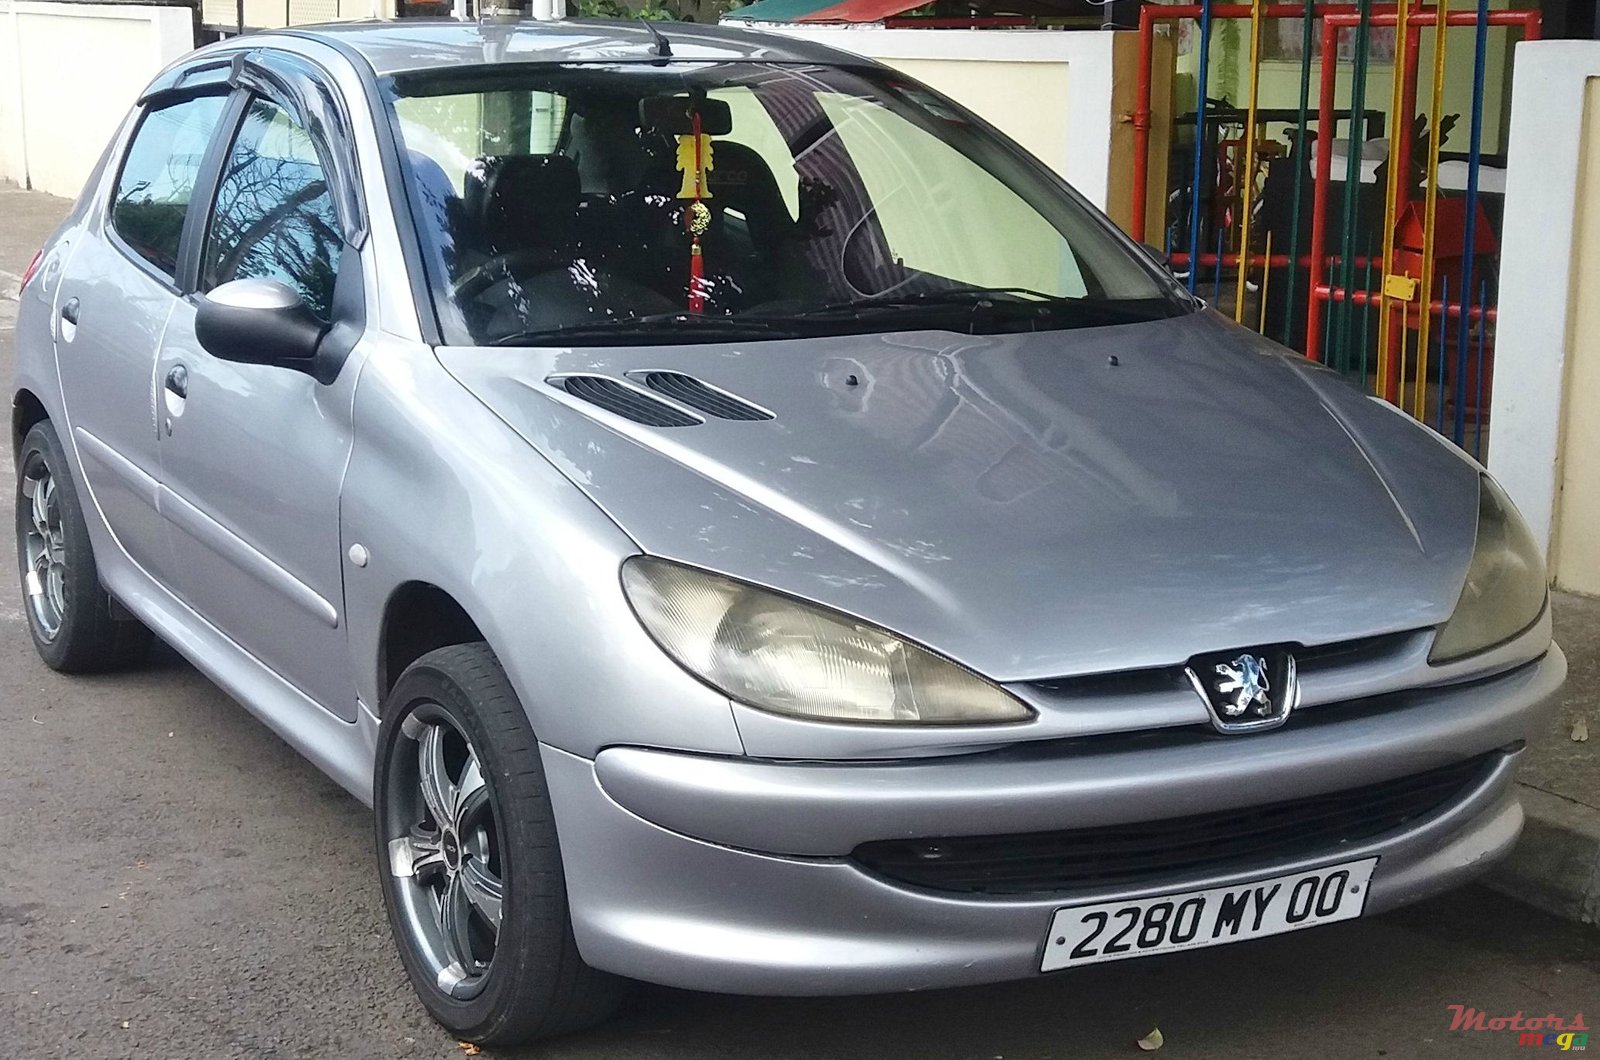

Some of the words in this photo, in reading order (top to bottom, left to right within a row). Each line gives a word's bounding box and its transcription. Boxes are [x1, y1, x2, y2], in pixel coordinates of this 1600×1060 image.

[1069, 898, 1205, 960] 2280
[1212, 884, 1282, 939] MY
[1285, 870, 1350, 923] 00
